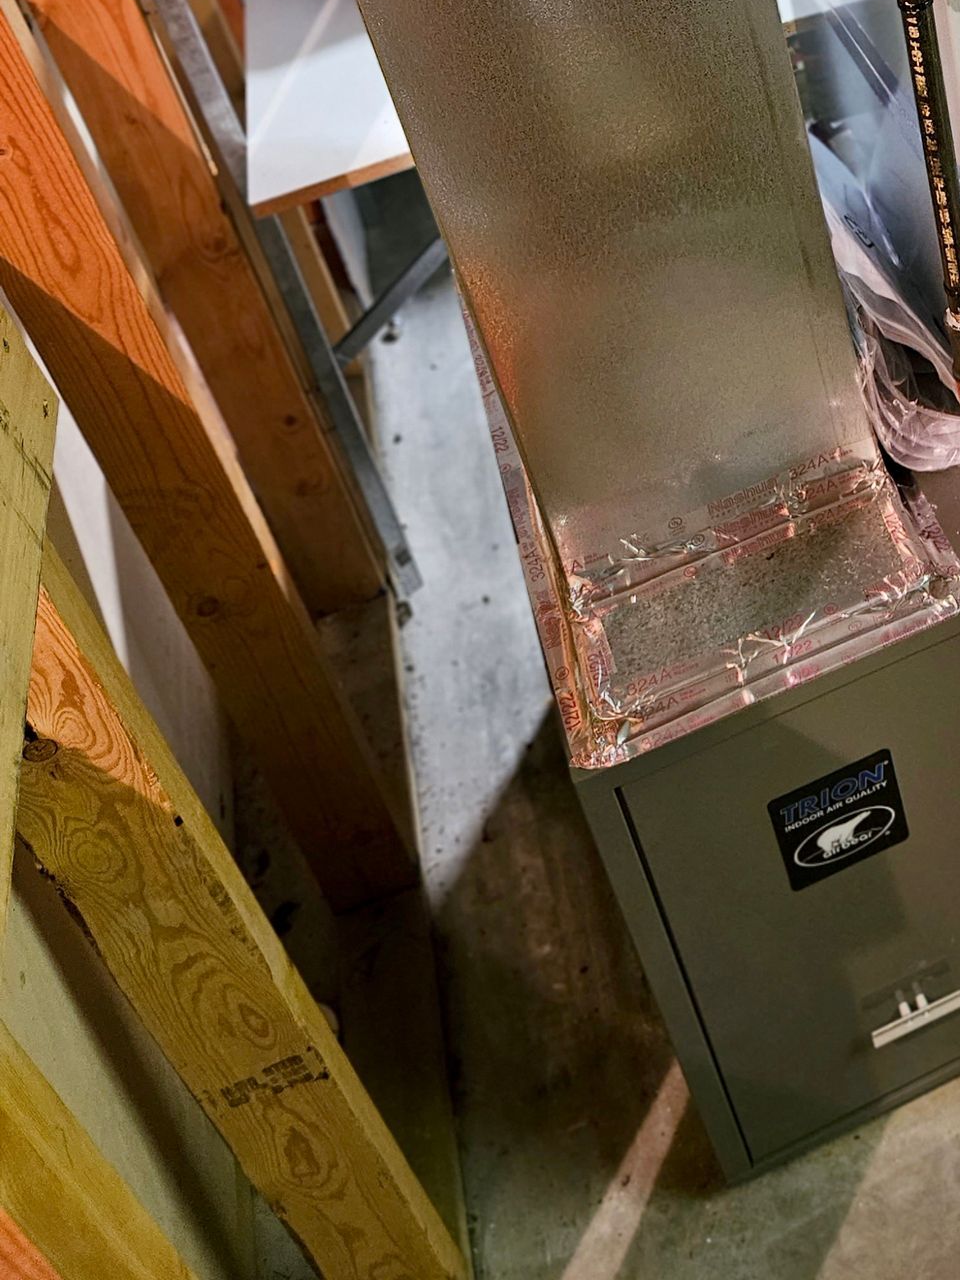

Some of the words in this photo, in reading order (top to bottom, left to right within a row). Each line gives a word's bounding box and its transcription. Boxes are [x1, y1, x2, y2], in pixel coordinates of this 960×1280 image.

[788, 454, 829, 481] 324A
[626, 667, 673, 696] 324A
[781, 762, 885, 825] TRION
[785, 809, 824, 833] INDOOR
[826, 801, 843, 815] AIR
[845, 780, 888, 805] QUALITY
